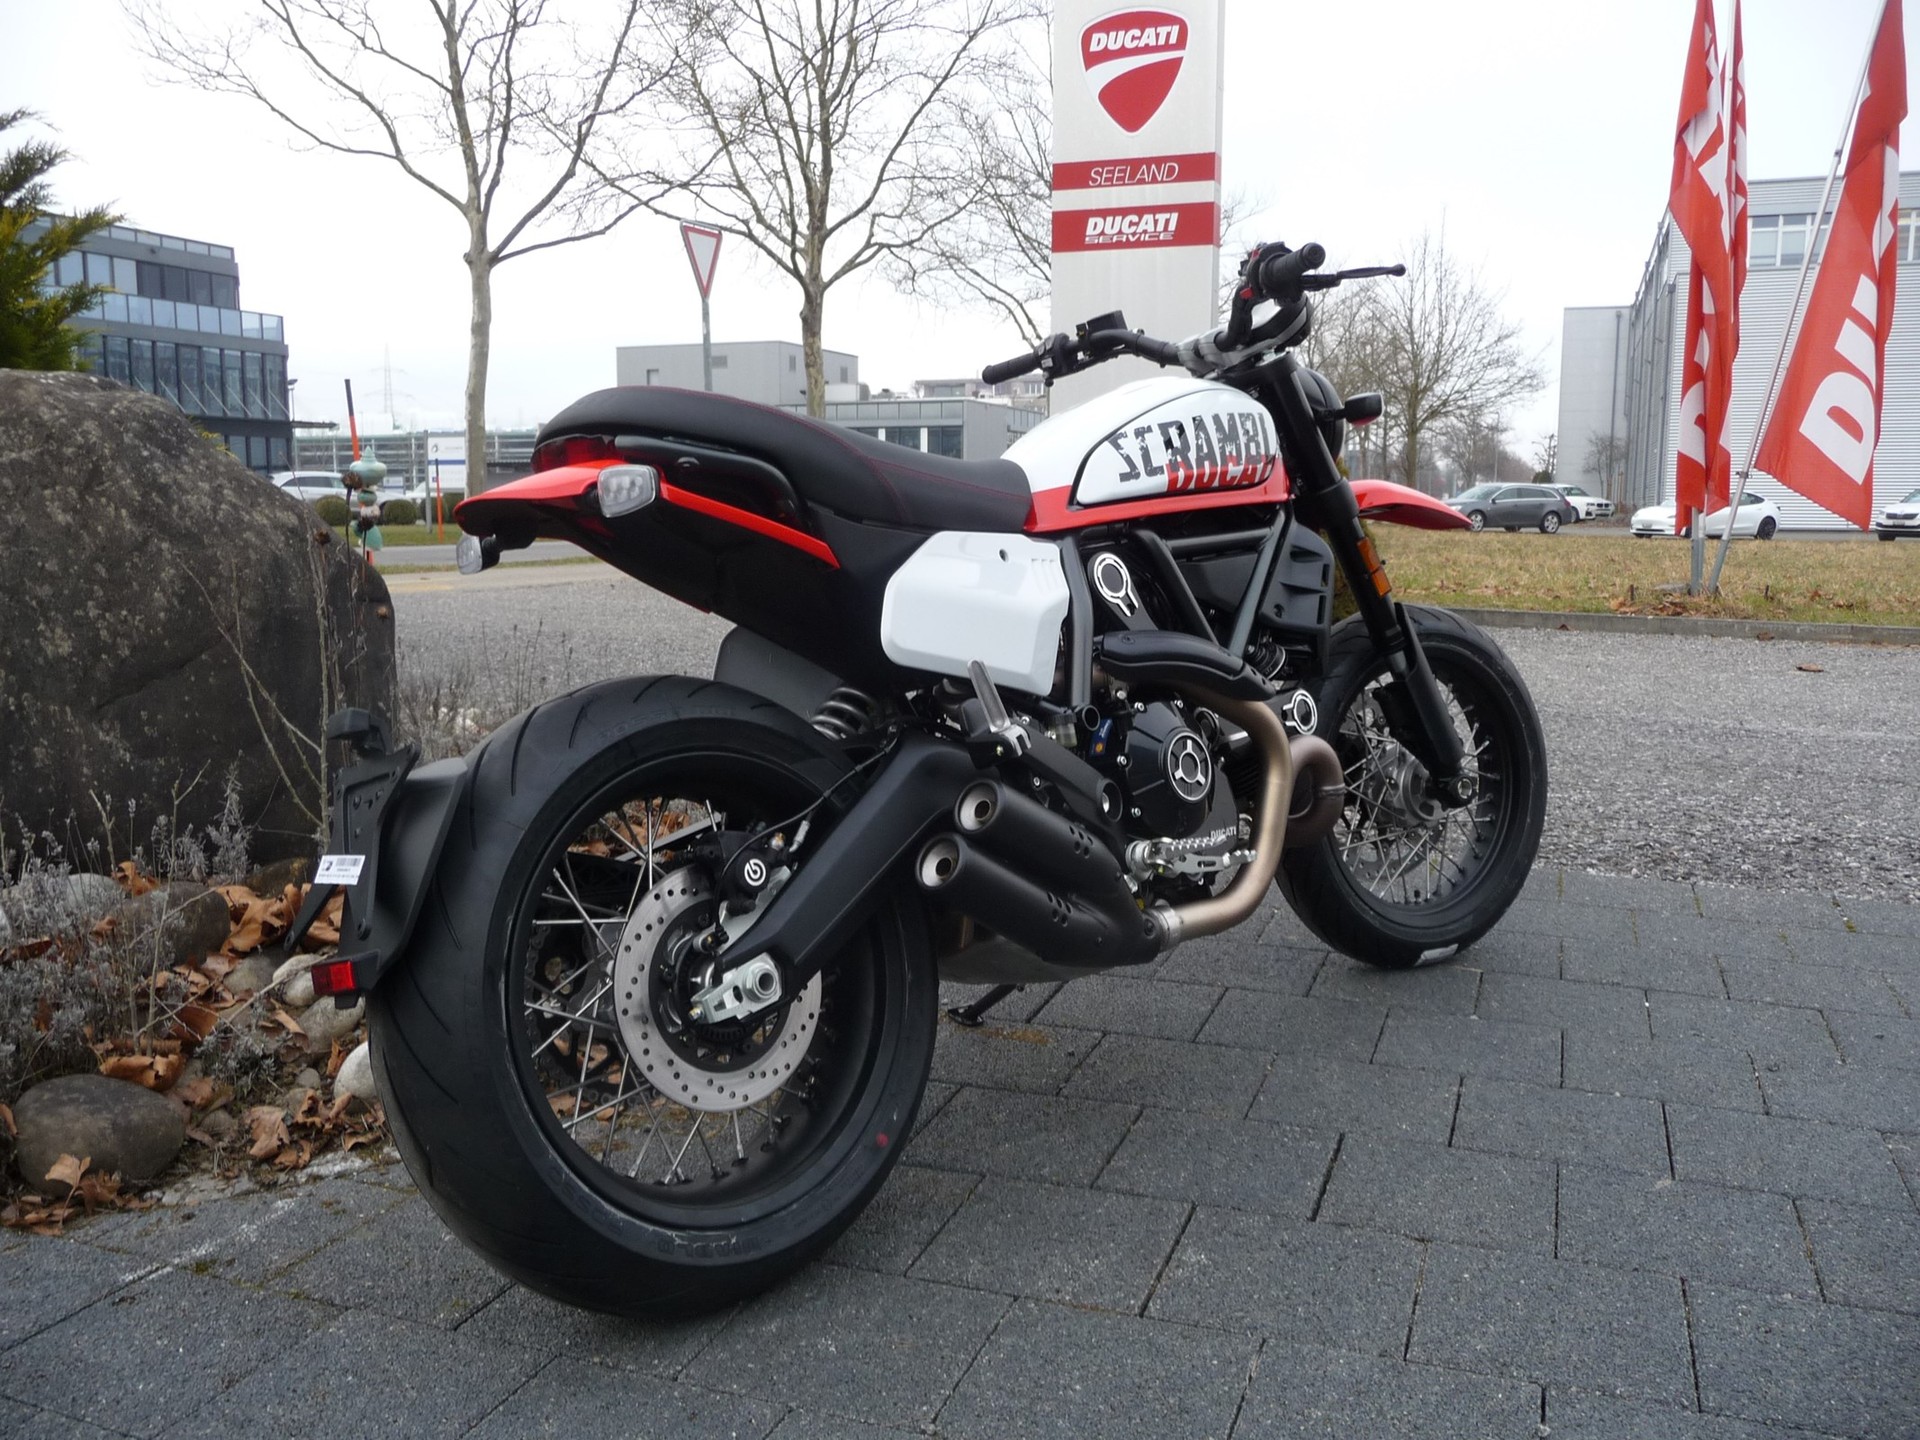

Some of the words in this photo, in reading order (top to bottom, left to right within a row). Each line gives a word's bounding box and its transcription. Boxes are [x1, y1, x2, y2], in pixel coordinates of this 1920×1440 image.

[1089, 25, 1179, 52] DUCATI
[1088, 161, 1179, 187] SEELAND
[1085, 212, 1178, 236] DUCATI
[1084, 232, 1174, 244] SERVICE
[1210, 826, 1237, 840] DUCATI
